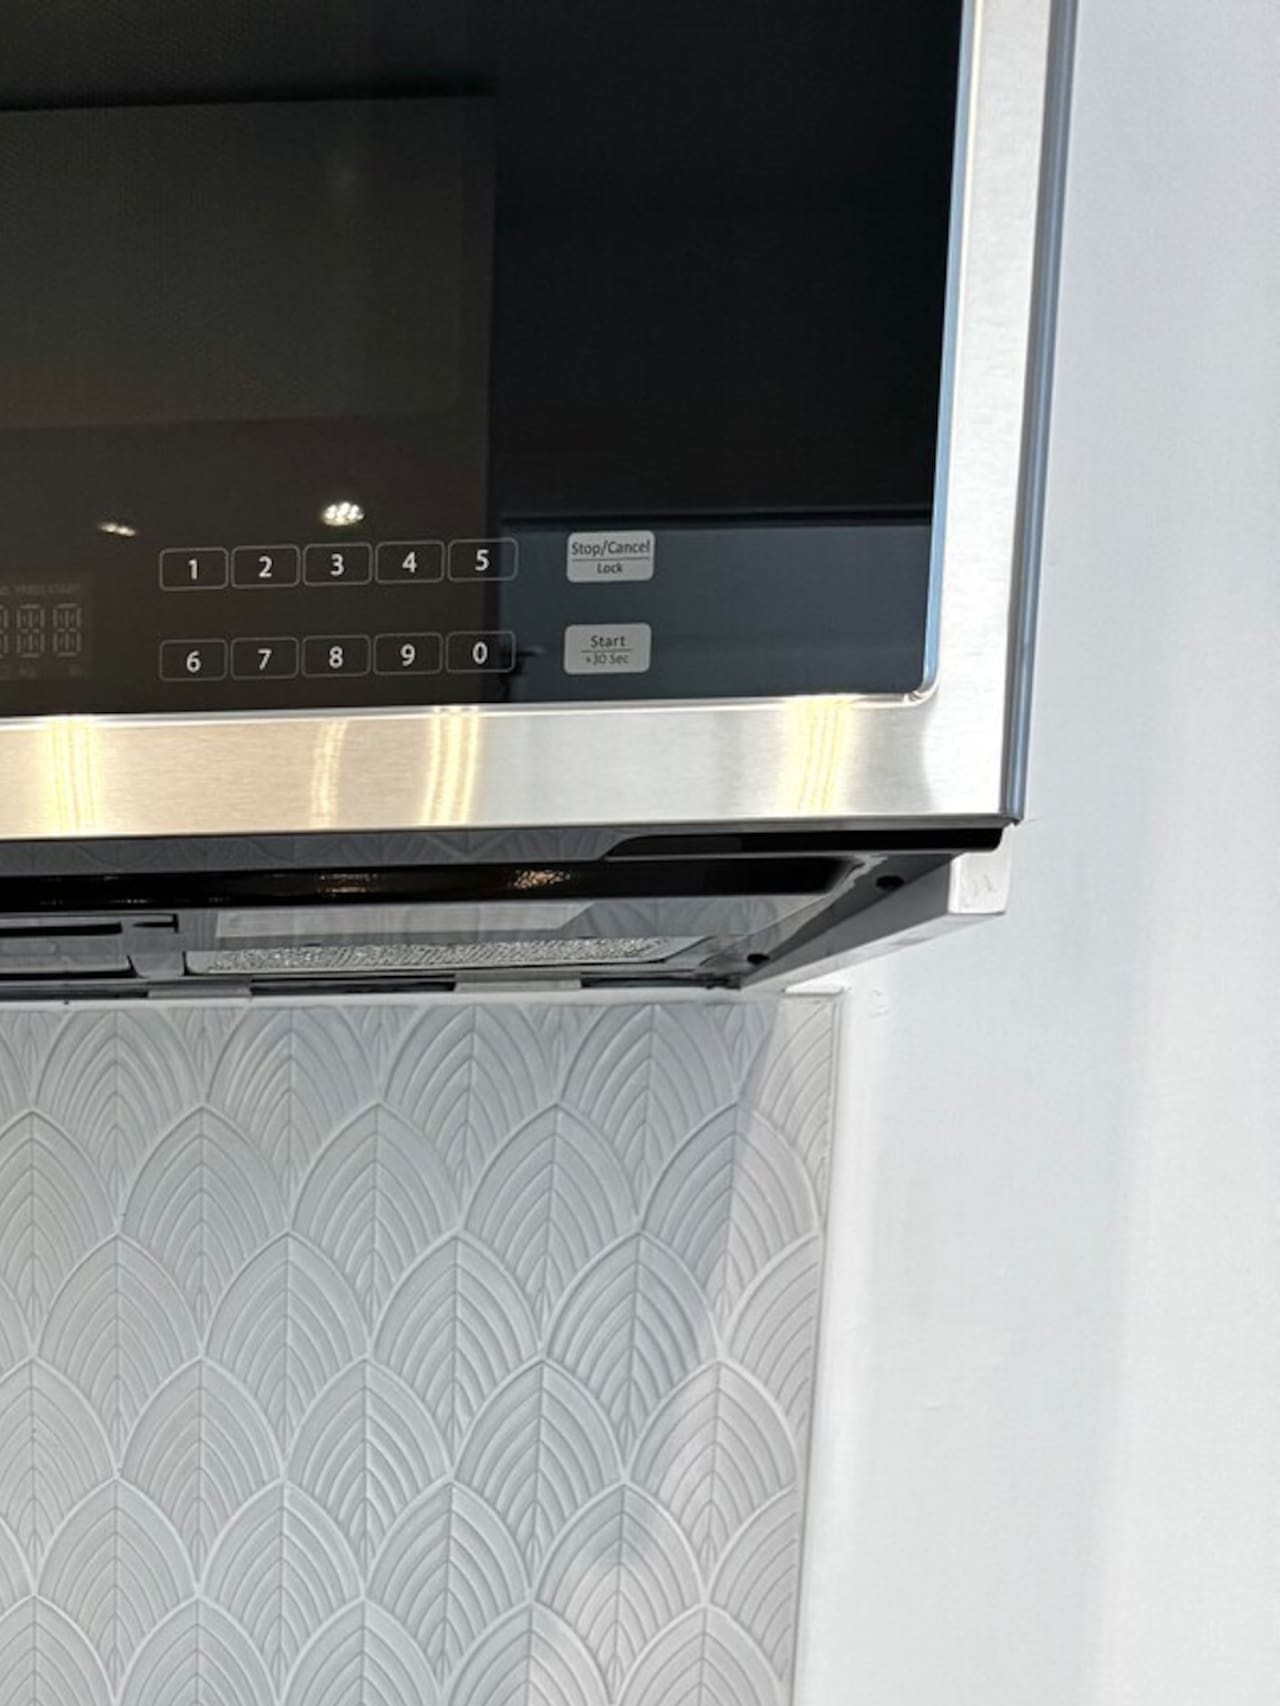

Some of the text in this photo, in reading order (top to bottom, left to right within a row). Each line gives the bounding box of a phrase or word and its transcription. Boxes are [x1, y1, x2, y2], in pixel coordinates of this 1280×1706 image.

[571, 540, 650, 556] Stop/Cancel
[188, 549, 490, 580] 1 2 3 4 5
[596, 562, 624, 574] Lock
[590, 634, 626, 648] Start
[186, 641, 488, 673] 6 7 8 9 0
